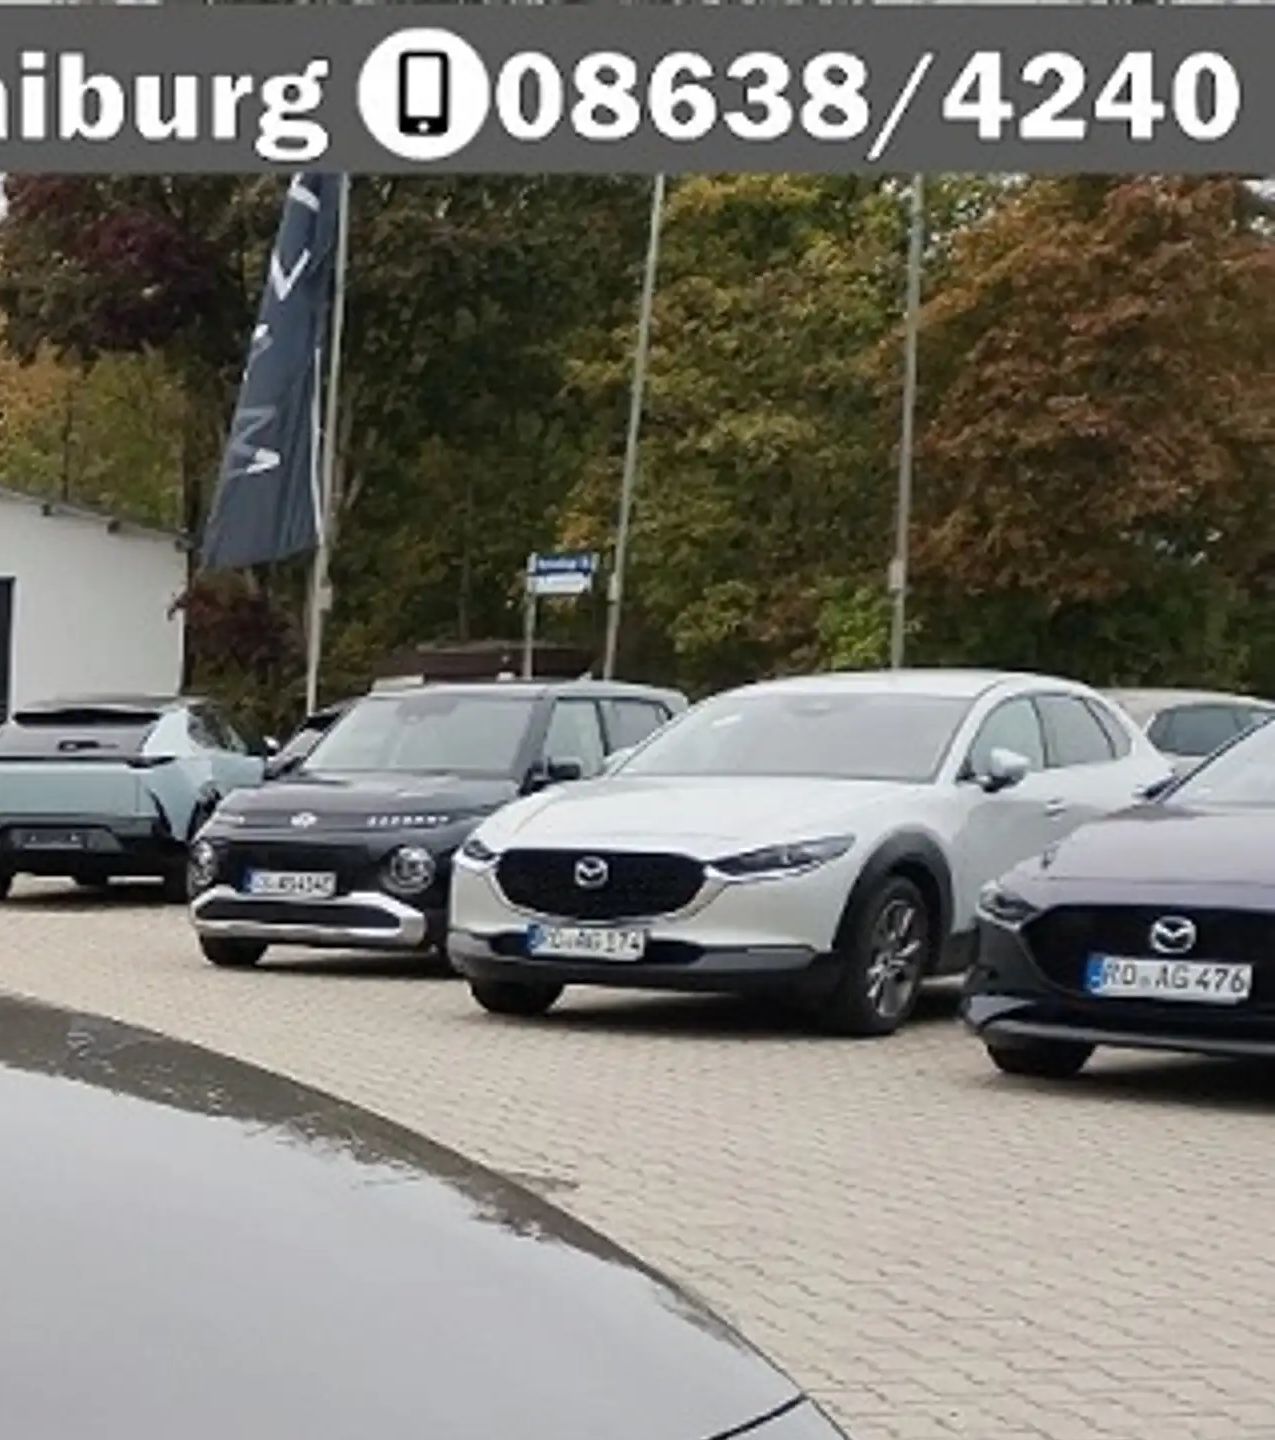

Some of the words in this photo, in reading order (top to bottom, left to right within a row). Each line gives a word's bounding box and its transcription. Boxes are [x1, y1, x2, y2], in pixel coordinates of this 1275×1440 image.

[1103, 962, 1137, 985] RO
[1155, 964, 1189, 989] AG
[1194, 967, 1246, 993] 476
